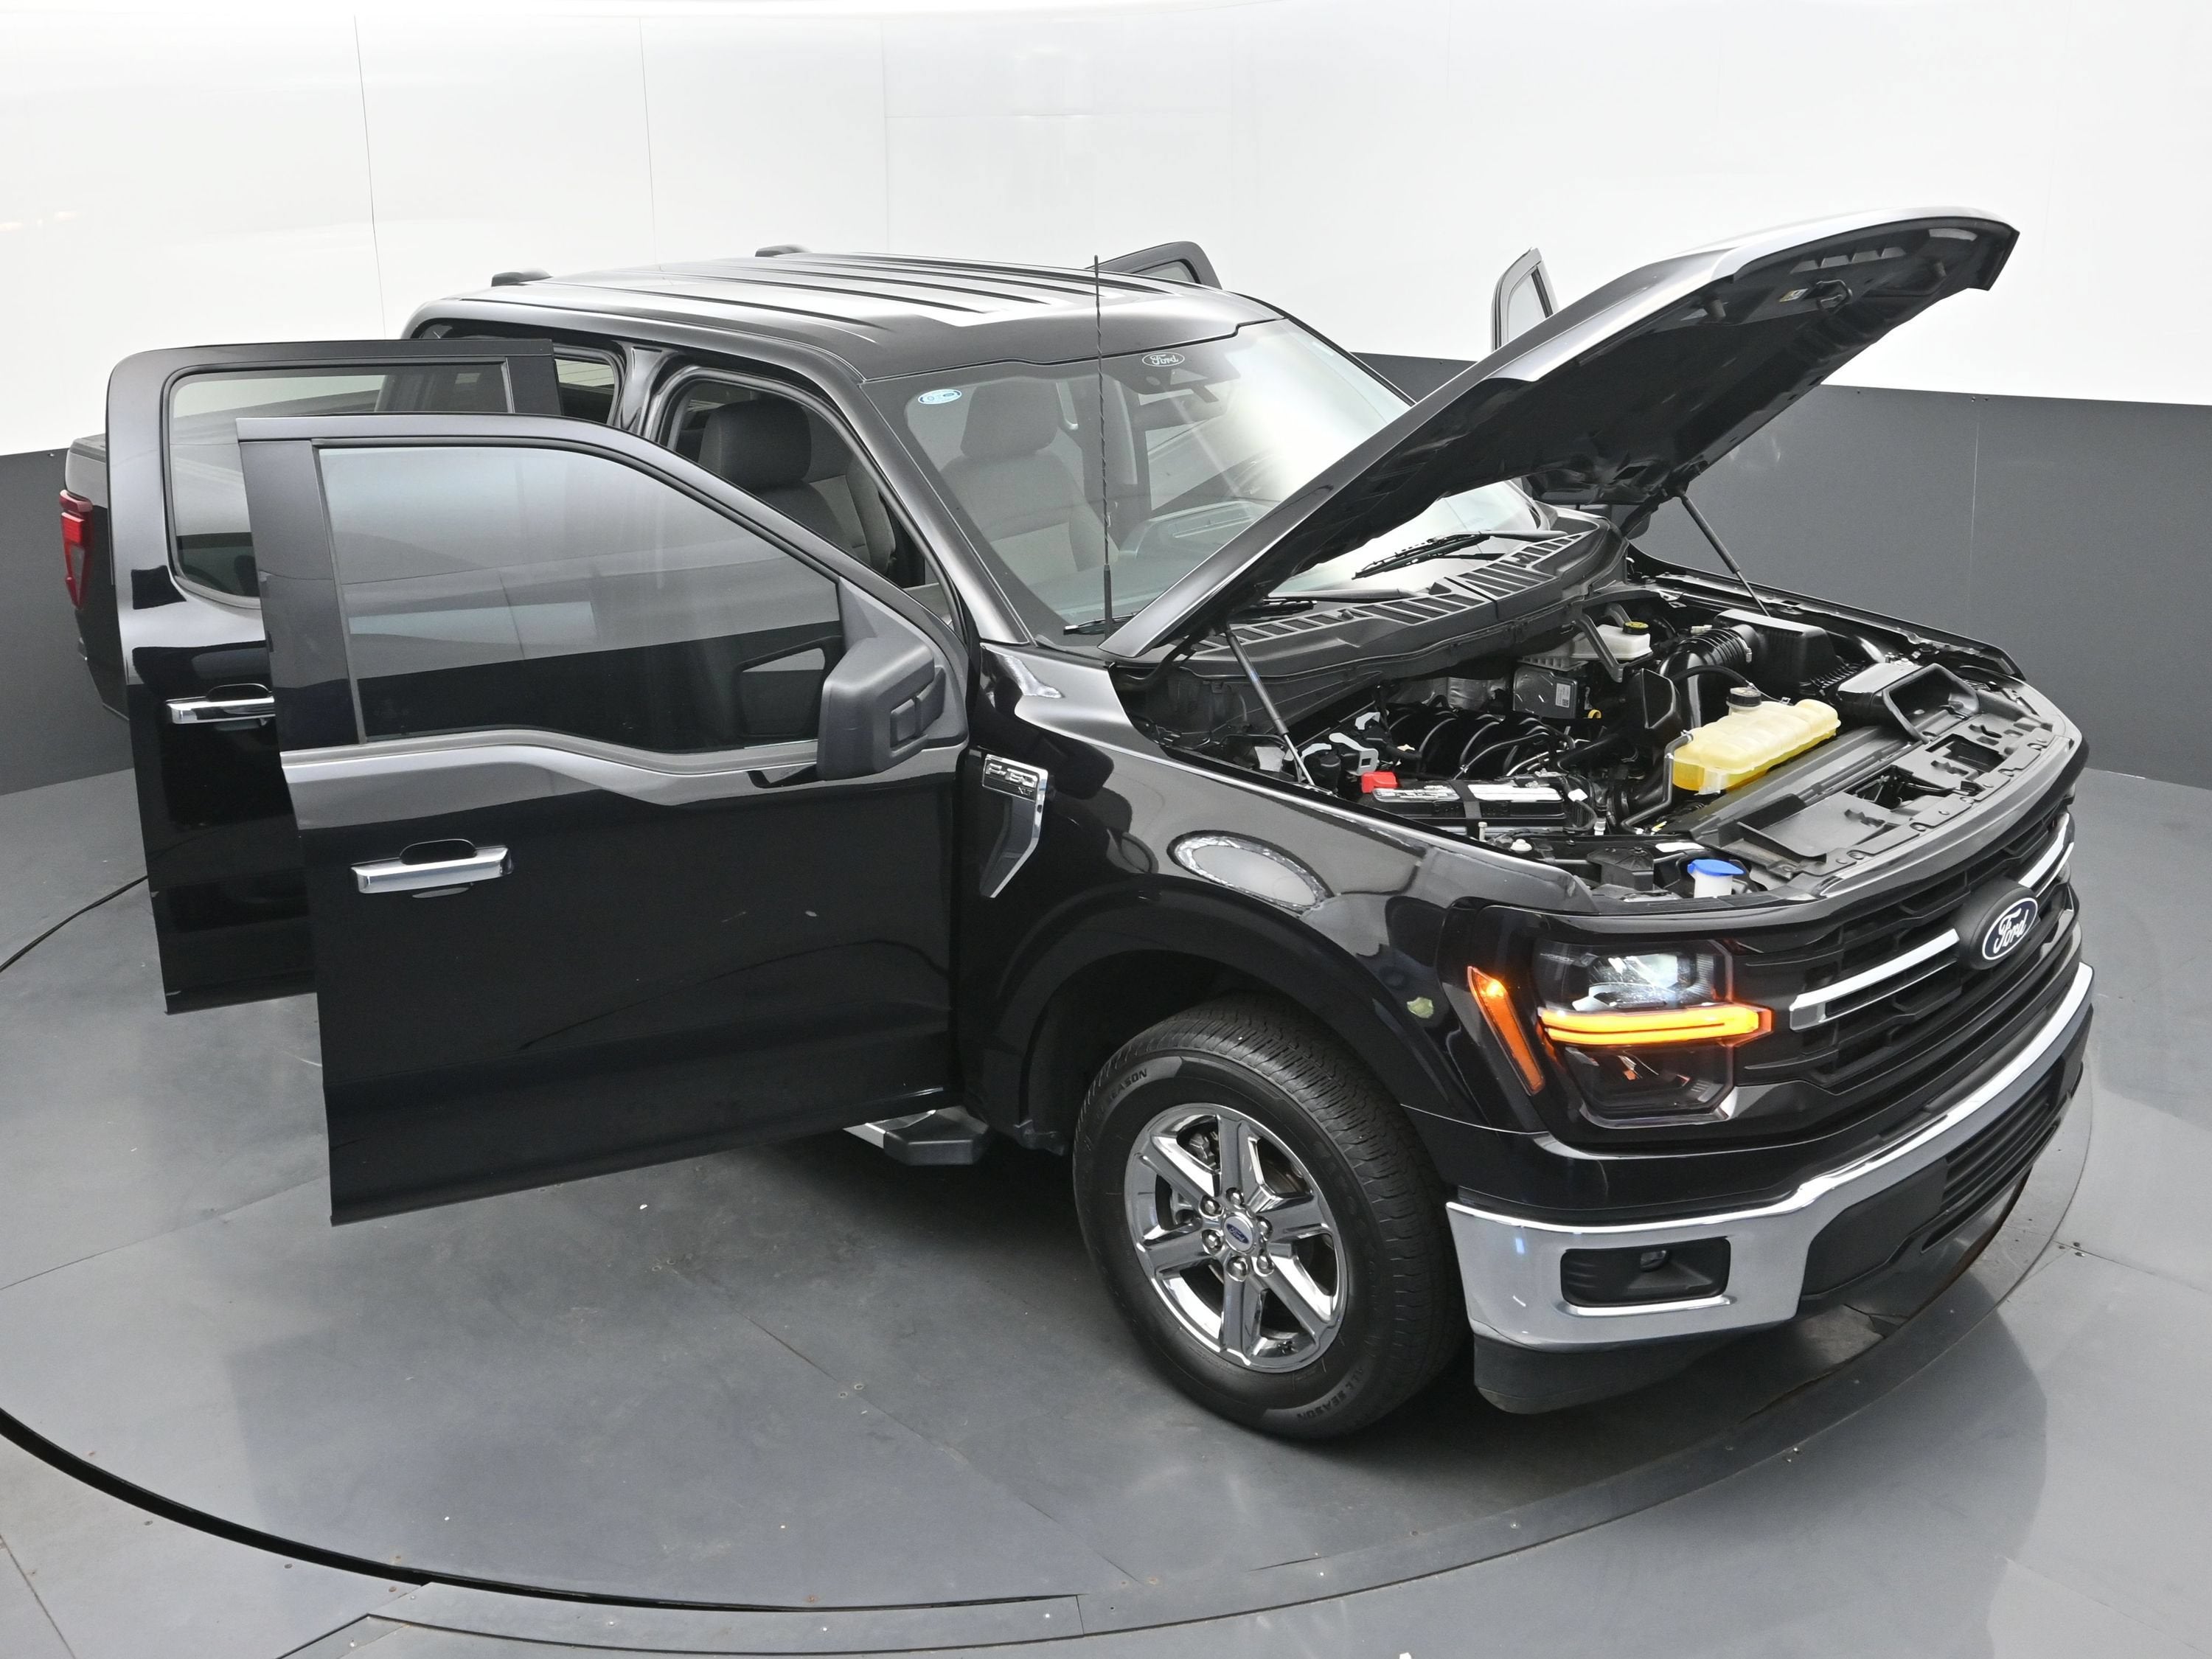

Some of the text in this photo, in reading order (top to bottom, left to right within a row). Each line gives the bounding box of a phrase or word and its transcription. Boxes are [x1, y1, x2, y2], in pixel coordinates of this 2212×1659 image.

[1150, 354, 1179, 365] Ford
[1018, 787, 1033, 796] XLT
[1992, 908, 2030, 954] Ford
